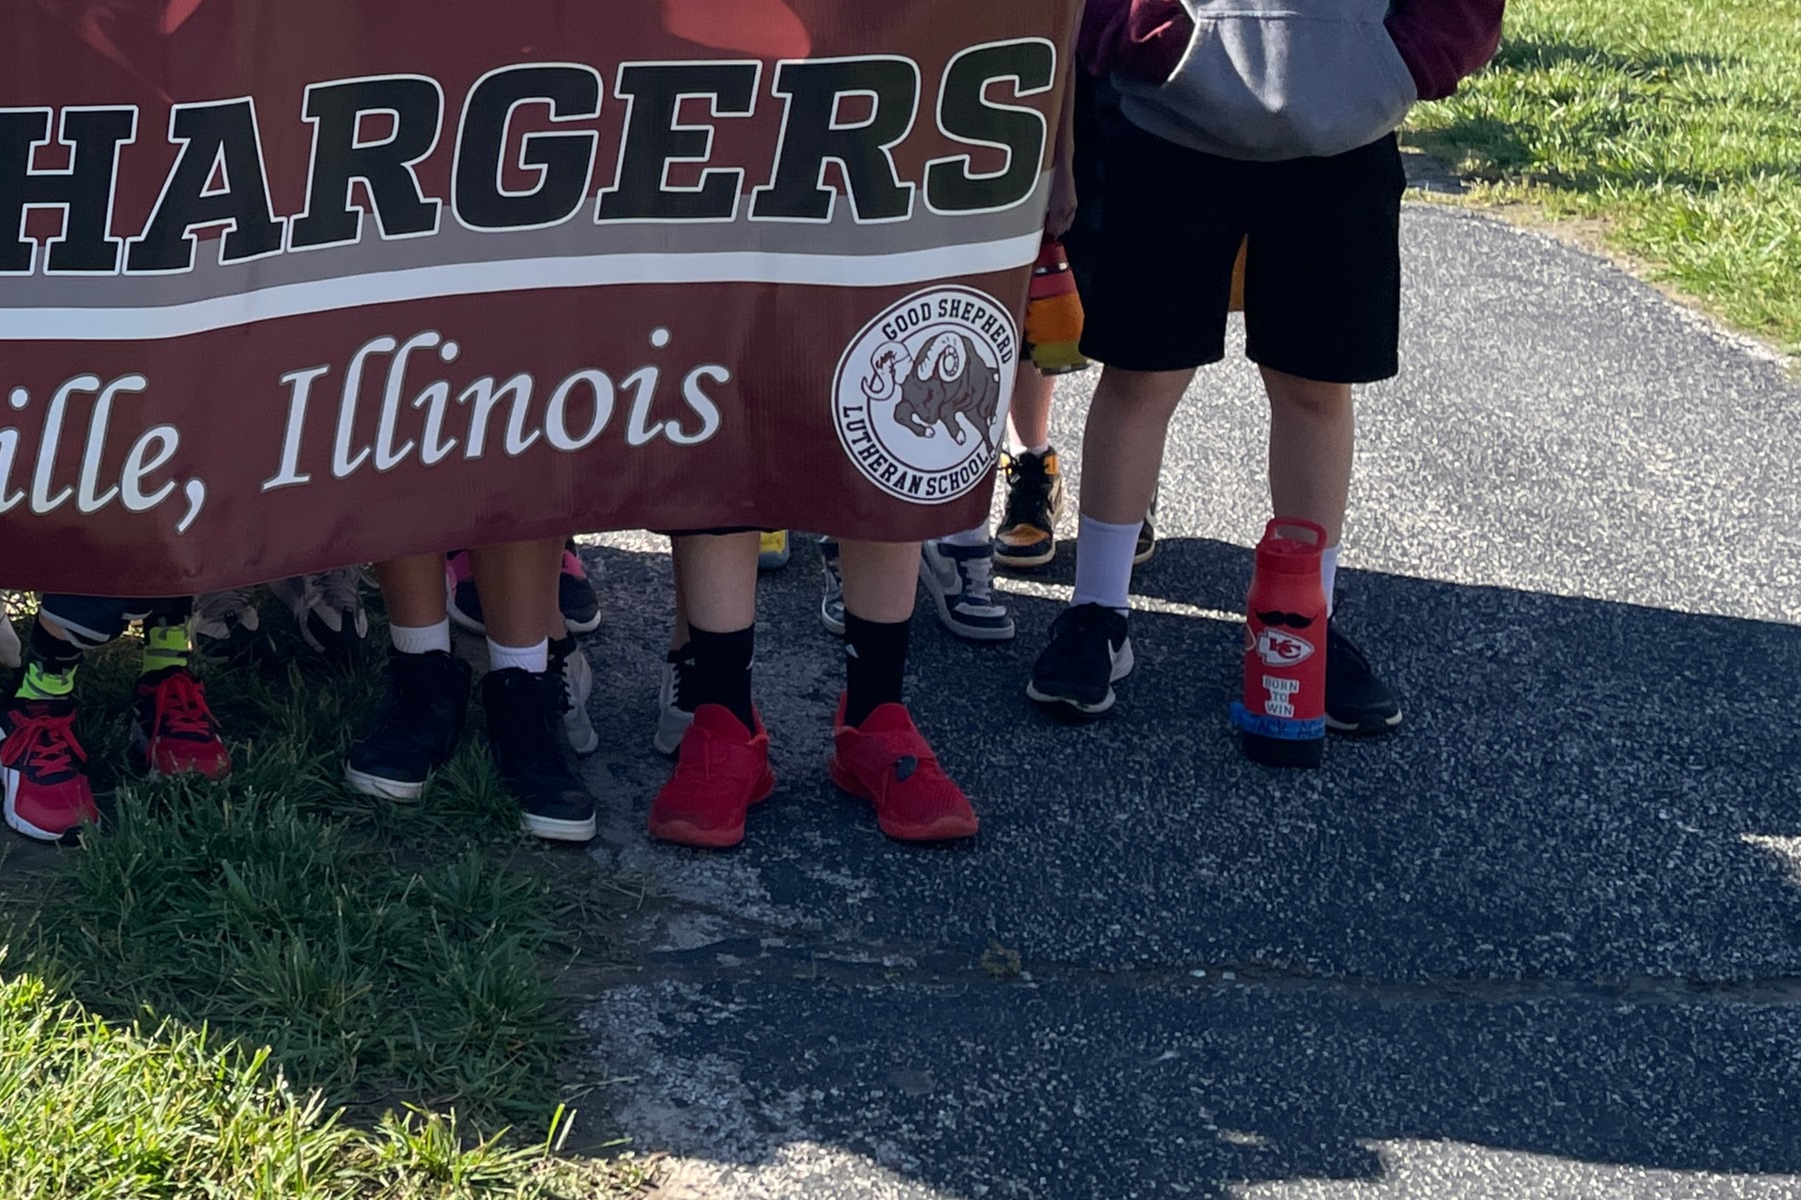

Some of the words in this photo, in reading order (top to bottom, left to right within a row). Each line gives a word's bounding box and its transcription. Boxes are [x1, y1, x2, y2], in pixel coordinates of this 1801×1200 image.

[882, 301, 932, 341] GOOD
[938, 298, 1014, 365] SHEPHERD
[261, 326, 731, 492] Illinois
[842, 405, 924, 495] LUTHERAN
[925, 451, 990, 497] SCHOOL
[1264, 677, 1298, 692] BORN
[1272, 691, 1288, 703] TO
[1266, 702, 1293, 716] WIN
